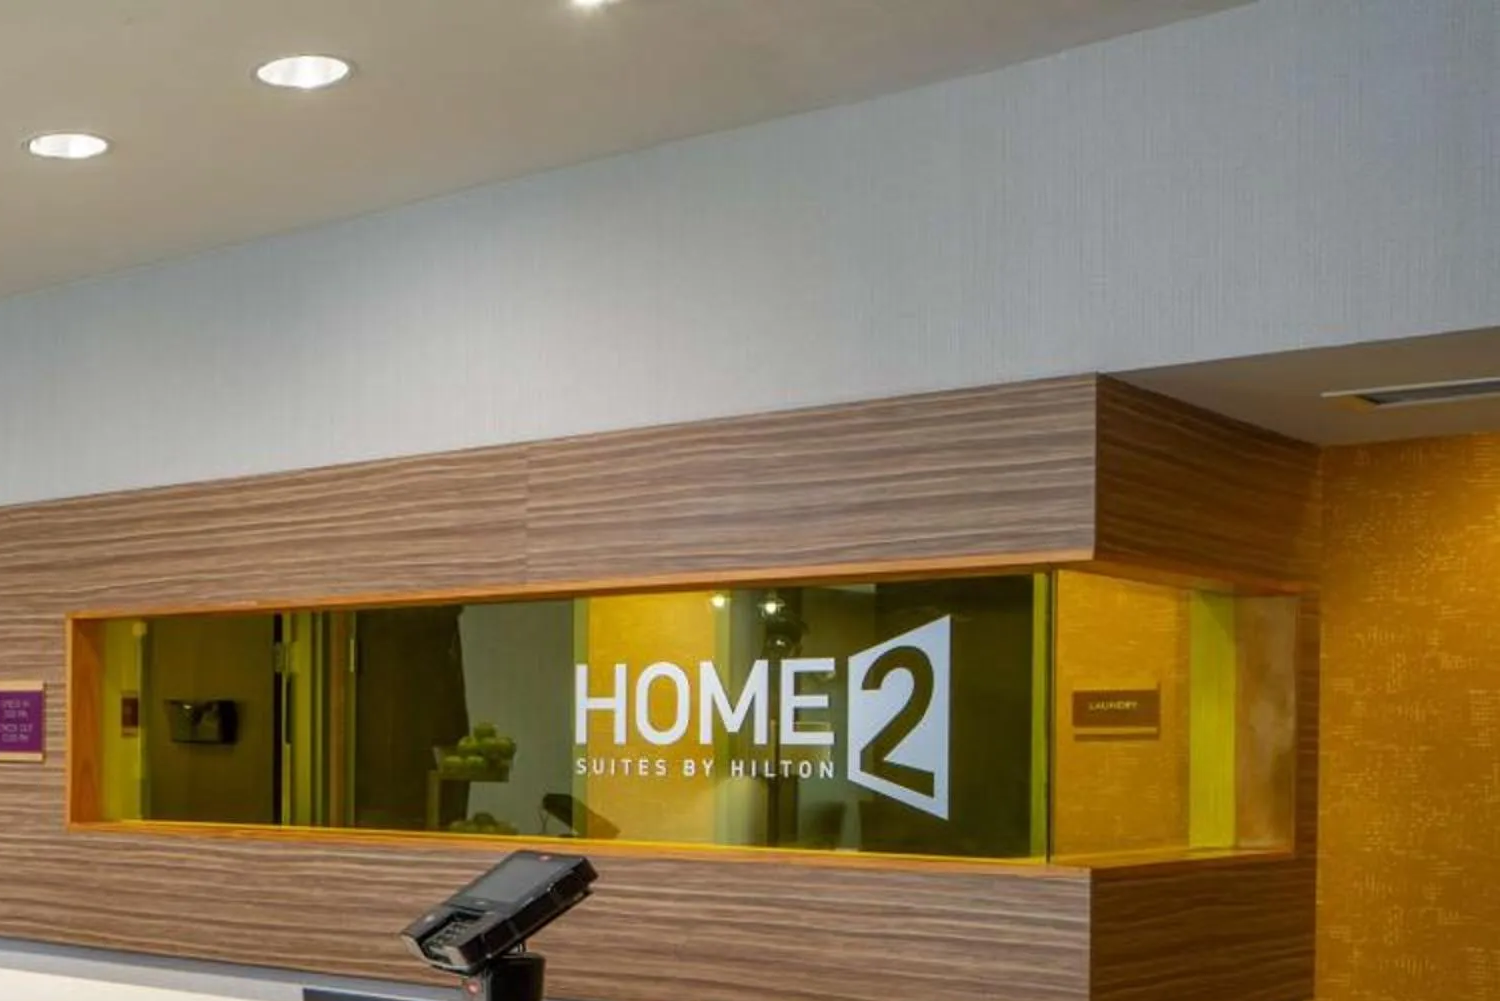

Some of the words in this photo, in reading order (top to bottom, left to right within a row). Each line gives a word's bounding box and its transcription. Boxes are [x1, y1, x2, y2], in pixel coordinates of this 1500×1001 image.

[575, 658, 835, 746] HOME
[860, 645, 935, 800] 2
[575, 758, 668, 777] SUITES
[683, 759, 715, 777] BY
[731, 760, 835, 779] HILTON
